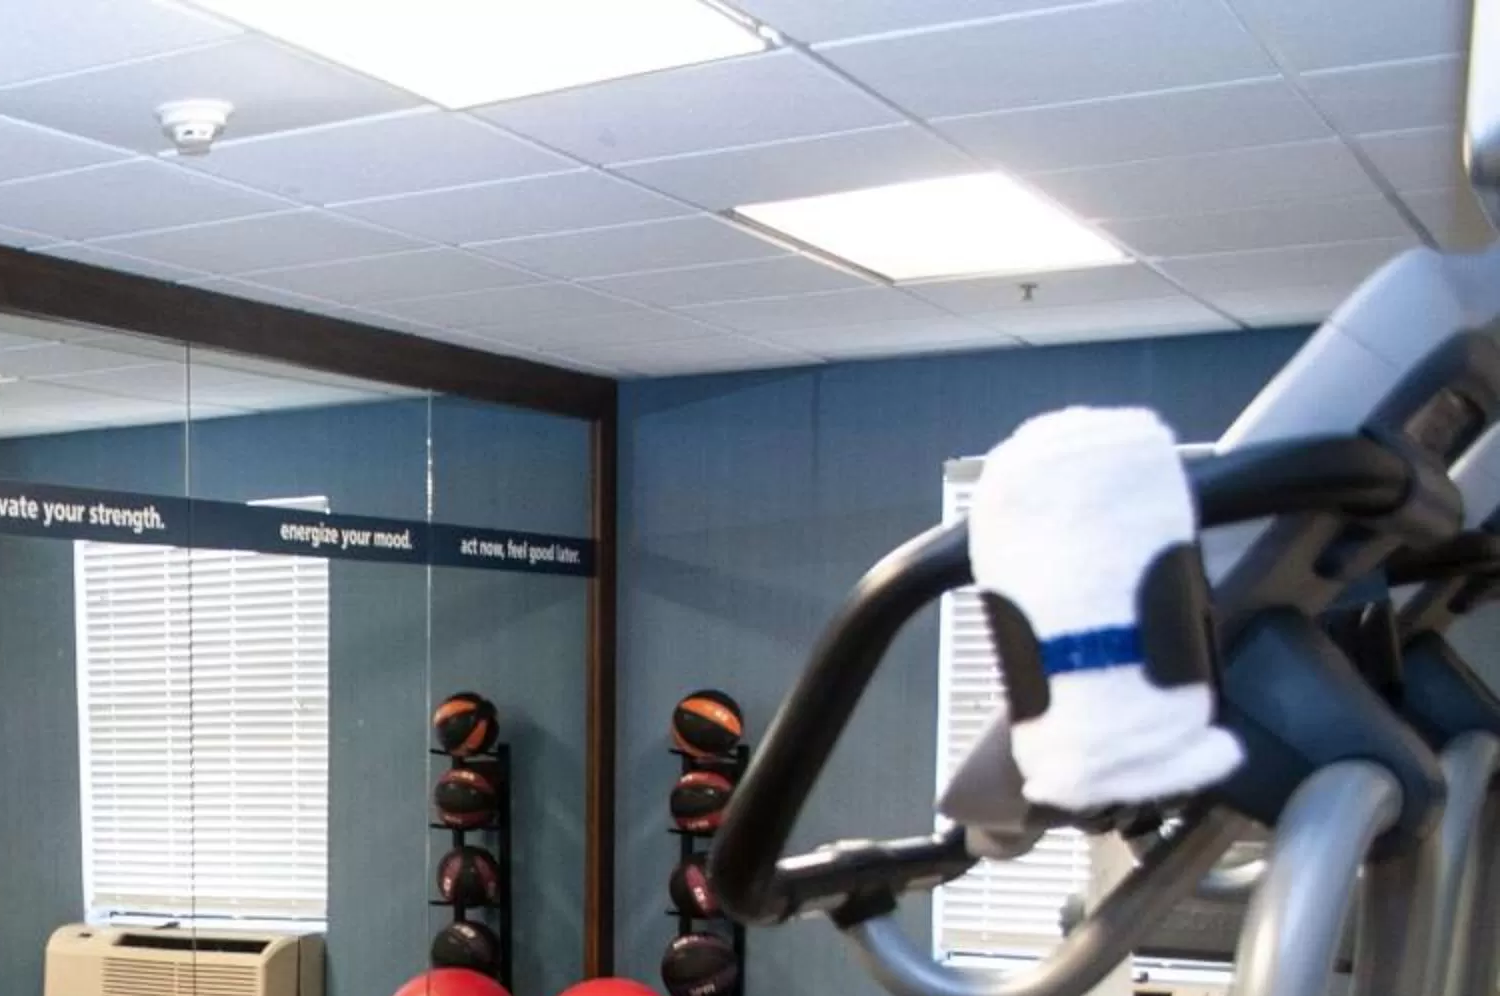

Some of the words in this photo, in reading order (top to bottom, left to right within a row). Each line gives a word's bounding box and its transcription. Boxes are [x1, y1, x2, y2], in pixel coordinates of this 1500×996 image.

[43, 501, 86, 527] your
[89, 503, 165, 534] strength.
[280, 521, 339, 548] energize
[341, 529, 372, 550] your
[373, 529, 413, 549] mood.
[460, 537, 478, 555] act
[507, 538, 527, 559] feel
[529, 544, 555, 564] good
